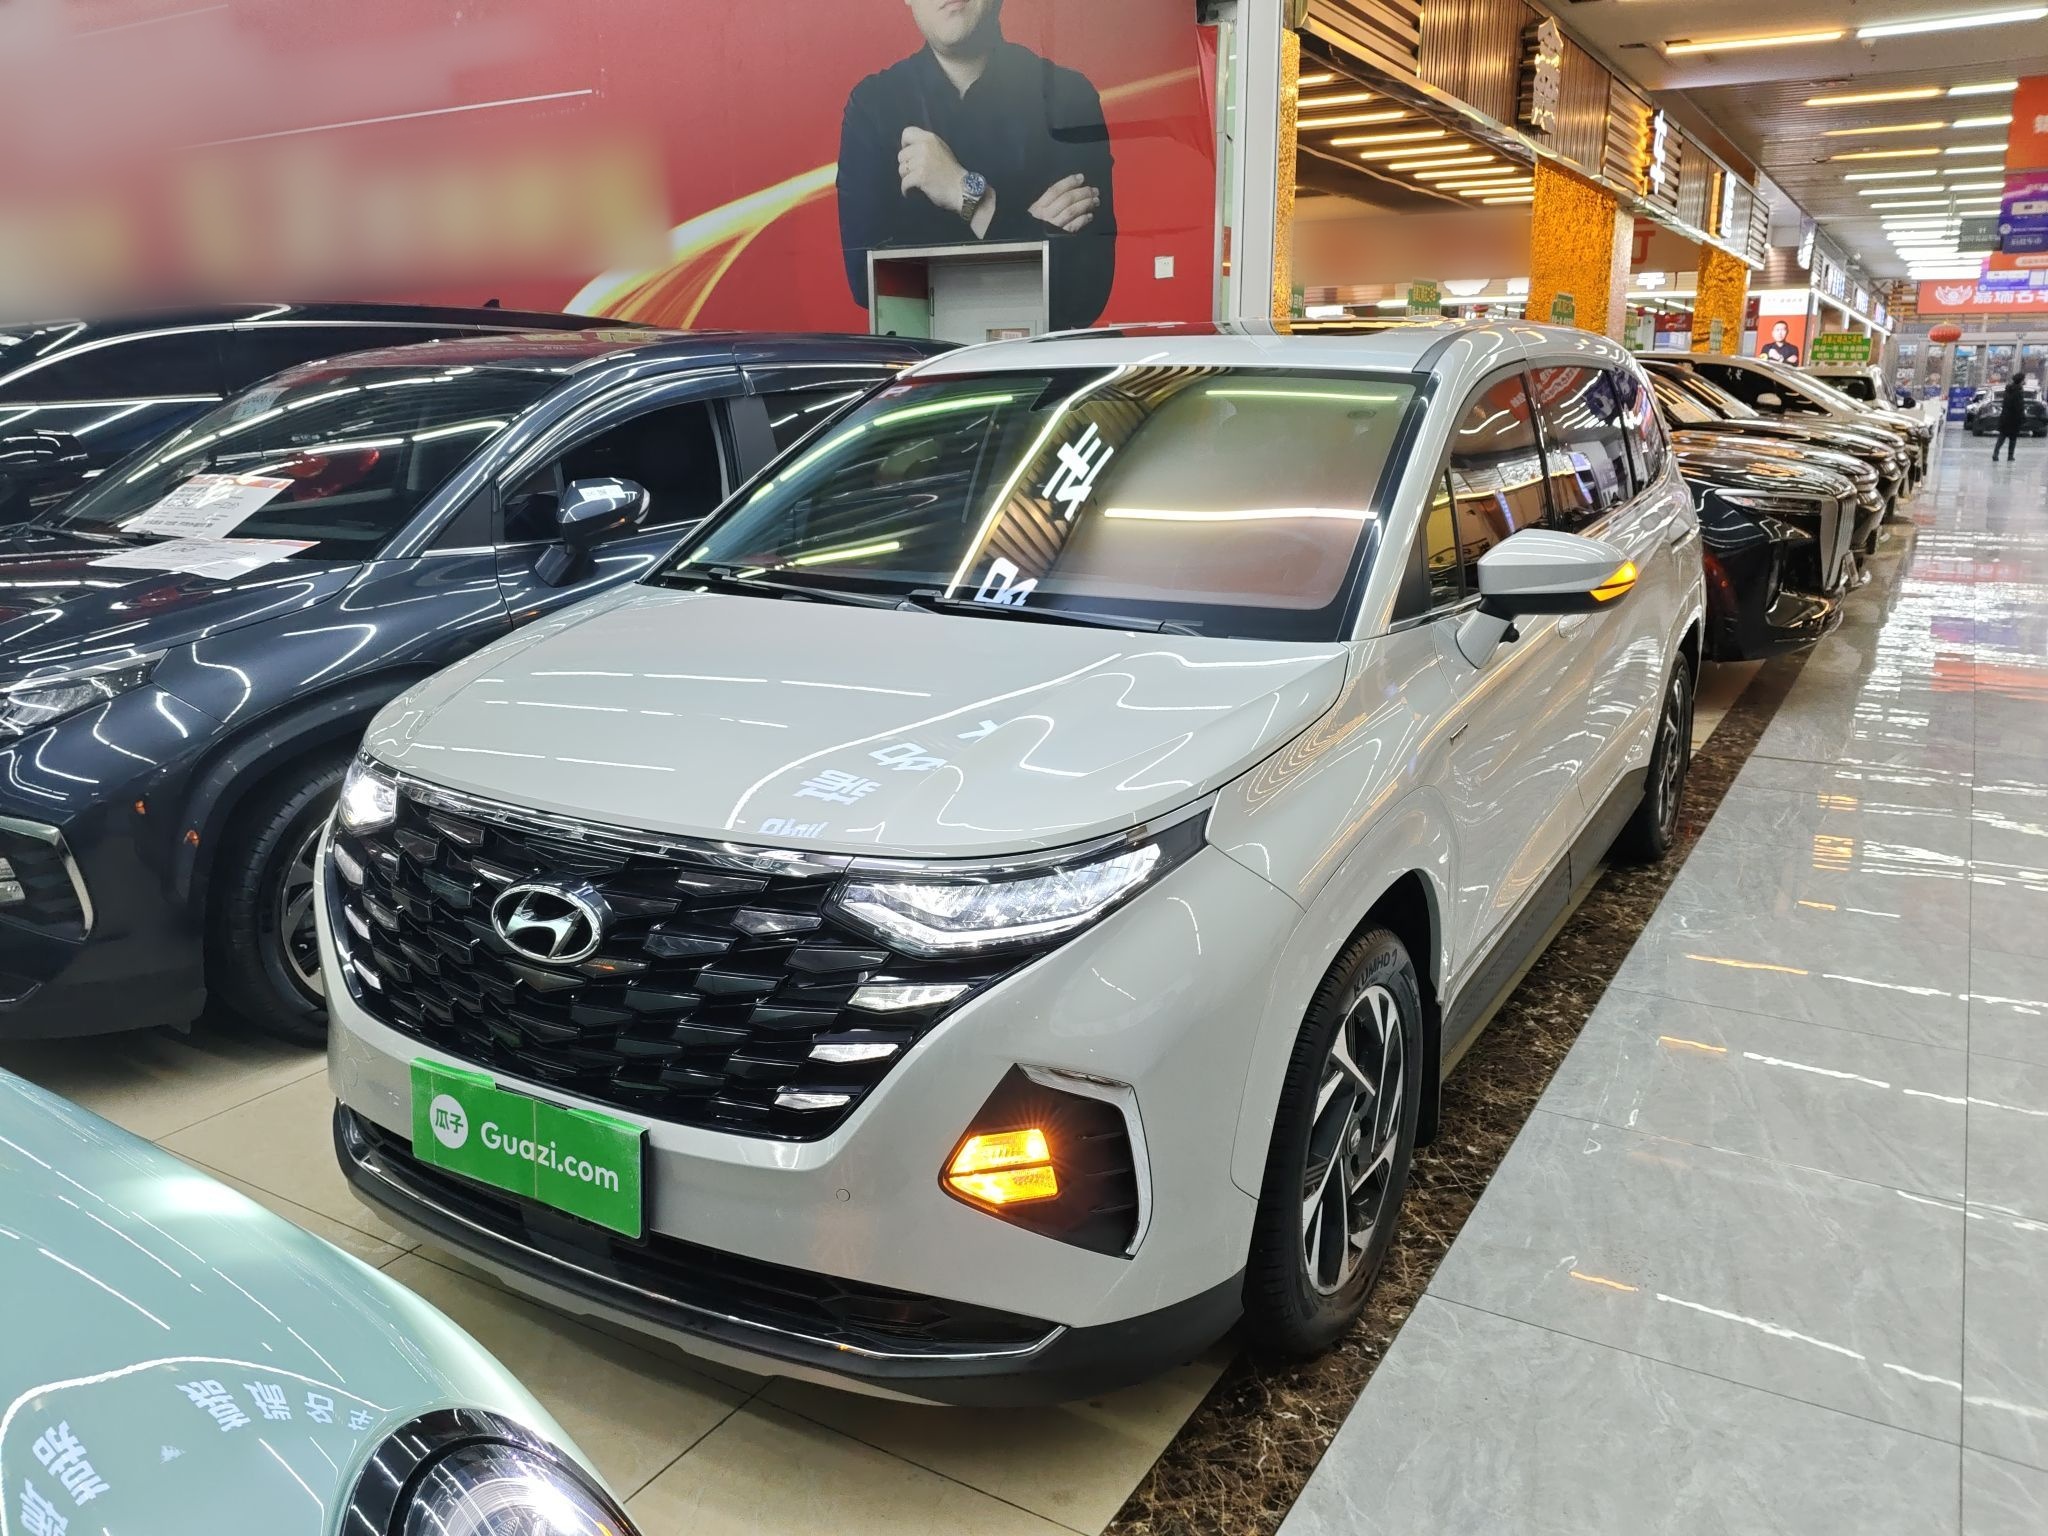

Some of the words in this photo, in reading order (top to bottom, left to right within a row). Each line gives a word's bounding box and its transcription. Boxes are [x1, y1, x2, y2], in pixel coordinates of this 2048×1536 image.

[1353, 951, 1391, 997] KUMHO
[435, 1107, 464, 1134] 瓜子
[480, 1121, 620, 1193] Guazi.com
